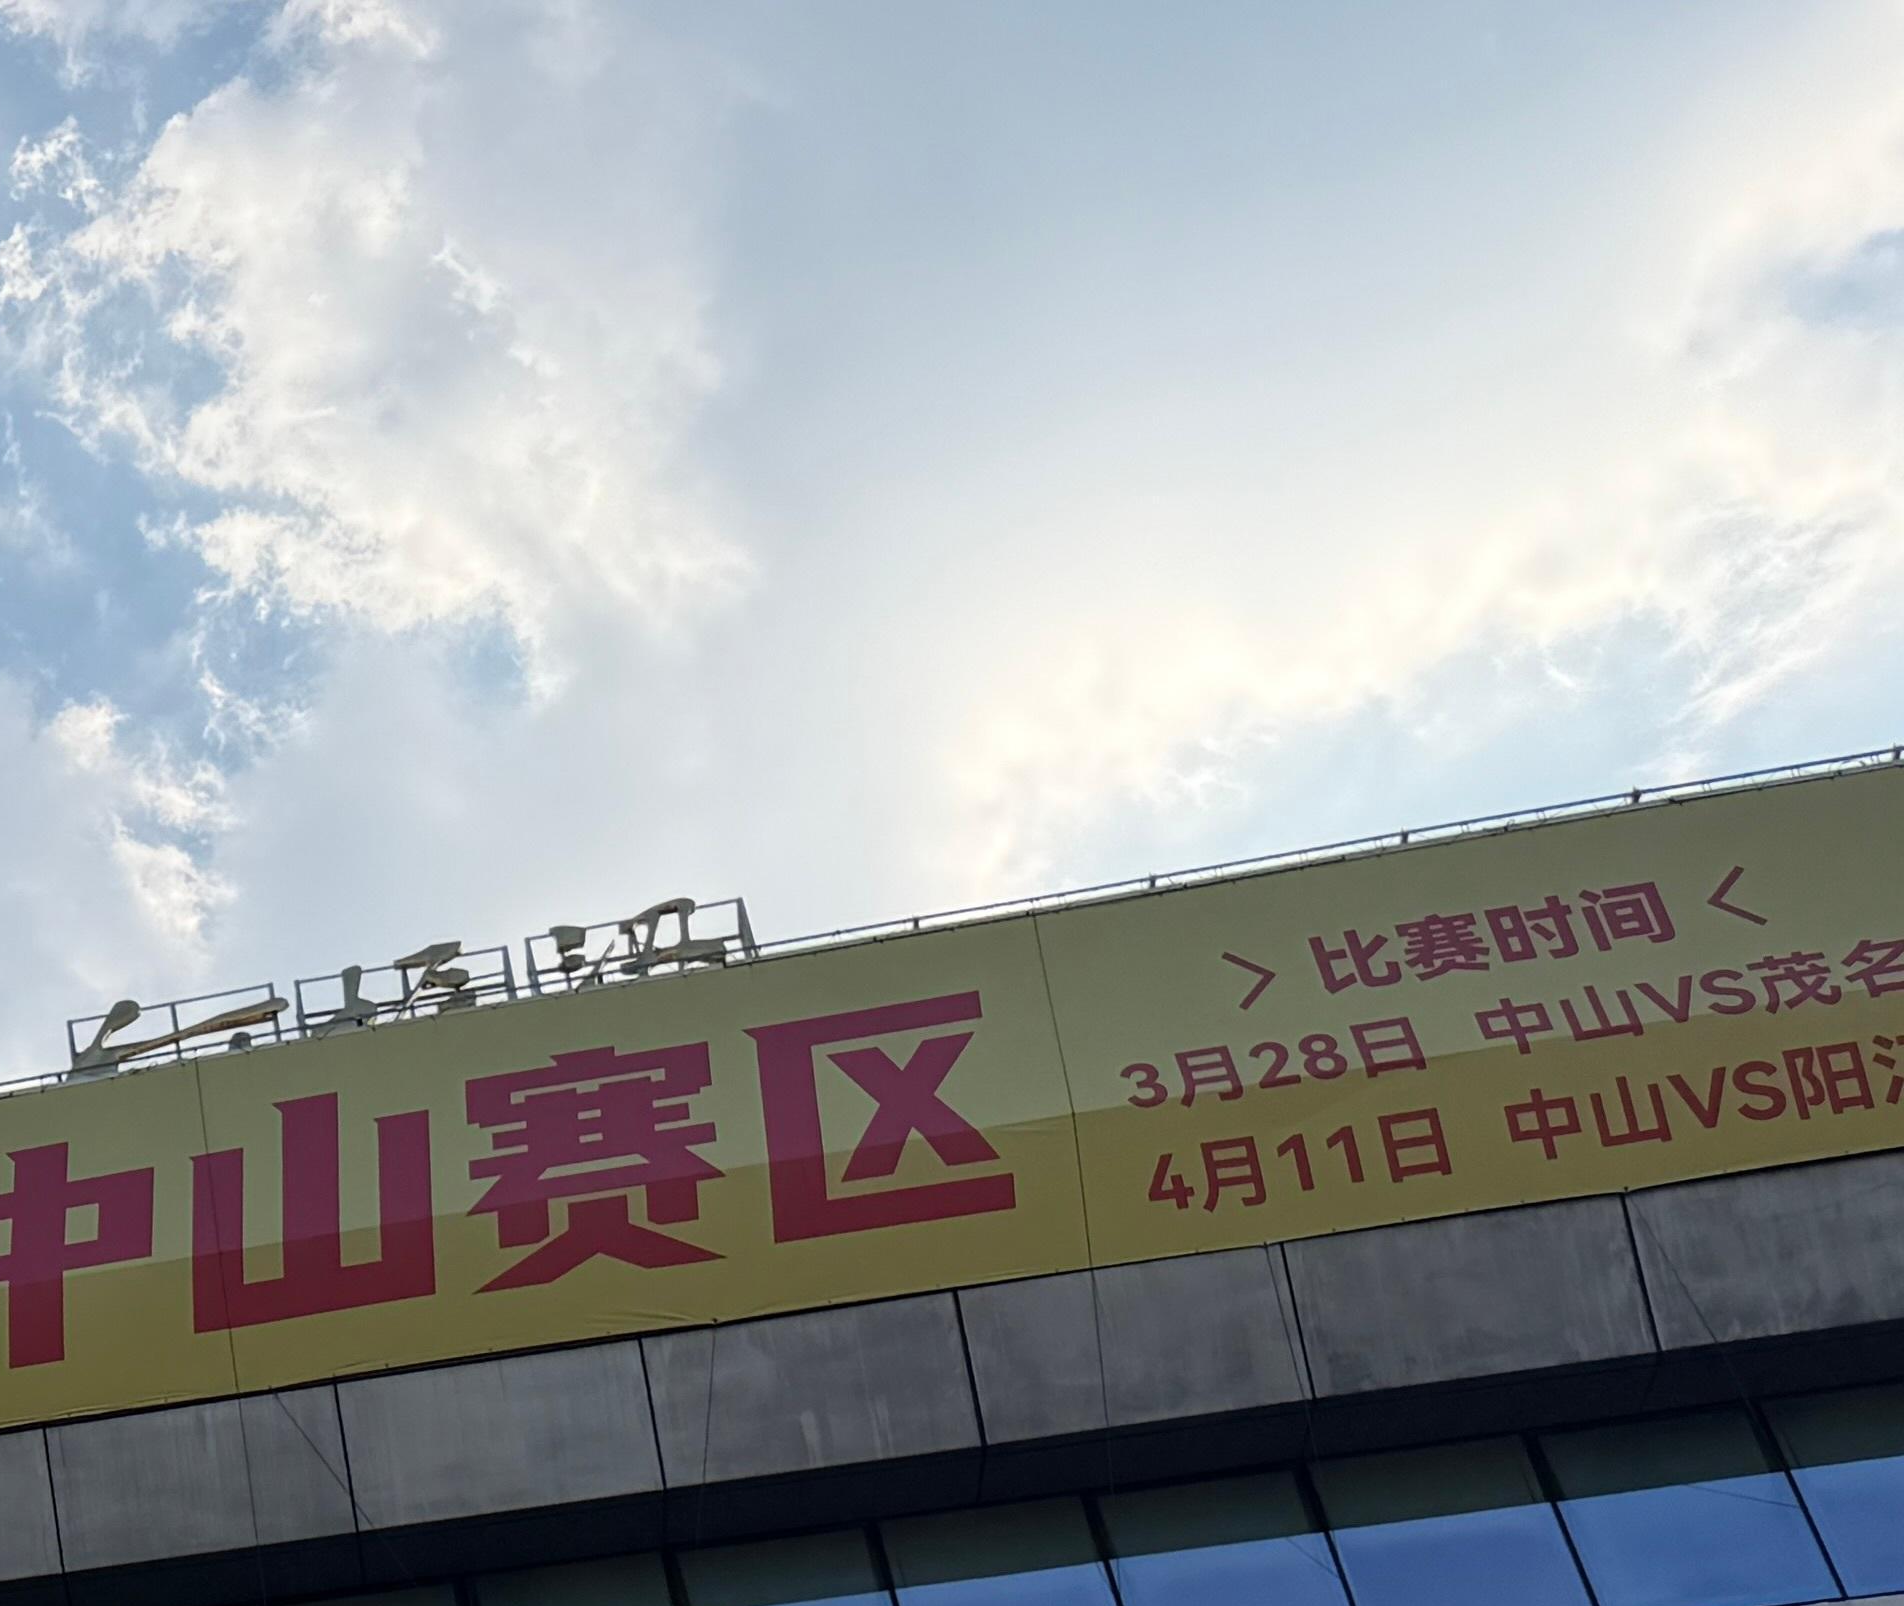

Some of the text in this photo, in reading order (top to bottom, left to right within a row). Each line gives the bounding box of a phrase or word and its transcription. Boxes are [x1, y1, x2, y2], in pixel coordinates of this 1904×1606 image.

[1308, 881, 1676, 995] 比赛时间
[1119, 938, 1904, 1109] 3月28日 中山VS茂名
[1146, 1106, 1453, 1214] 4月11日
